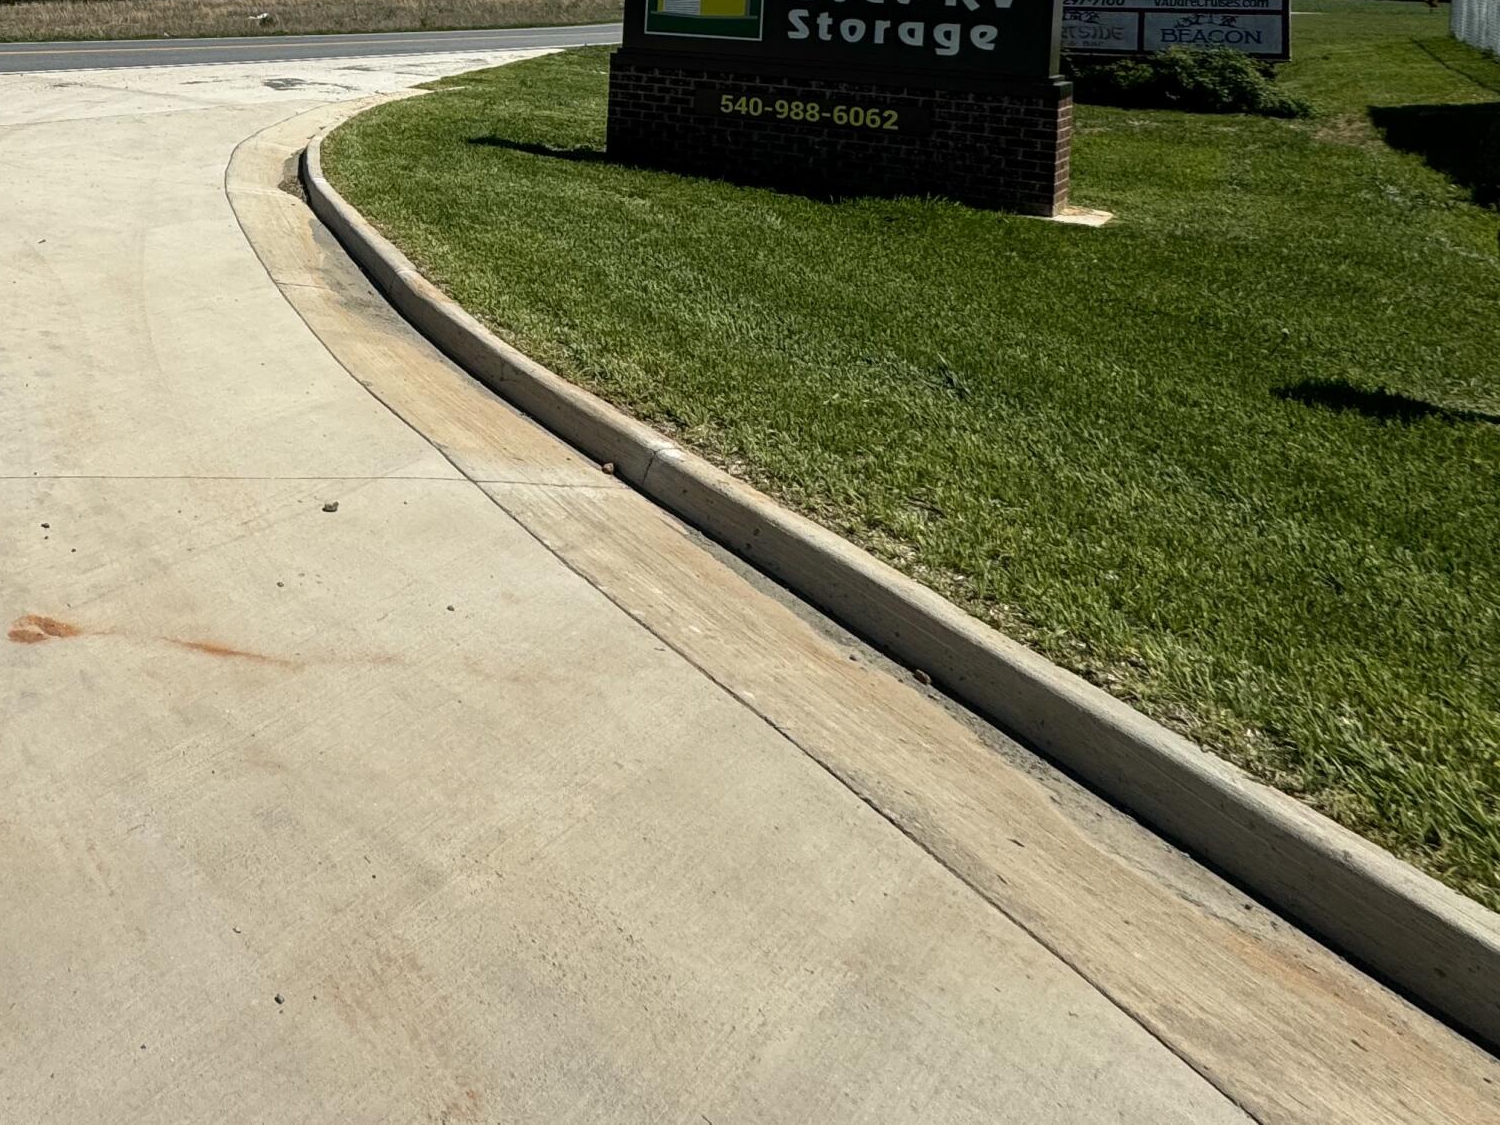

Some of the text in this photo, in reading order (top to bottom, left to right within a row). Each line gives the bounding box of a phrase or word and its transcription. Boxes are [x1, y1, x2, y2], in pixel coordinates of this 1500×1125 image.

[788, 9, 998, 56] Storage
[1160, 28, 1262, 44] BEACON
[721, 95, 899, 130] 540-988-6062
